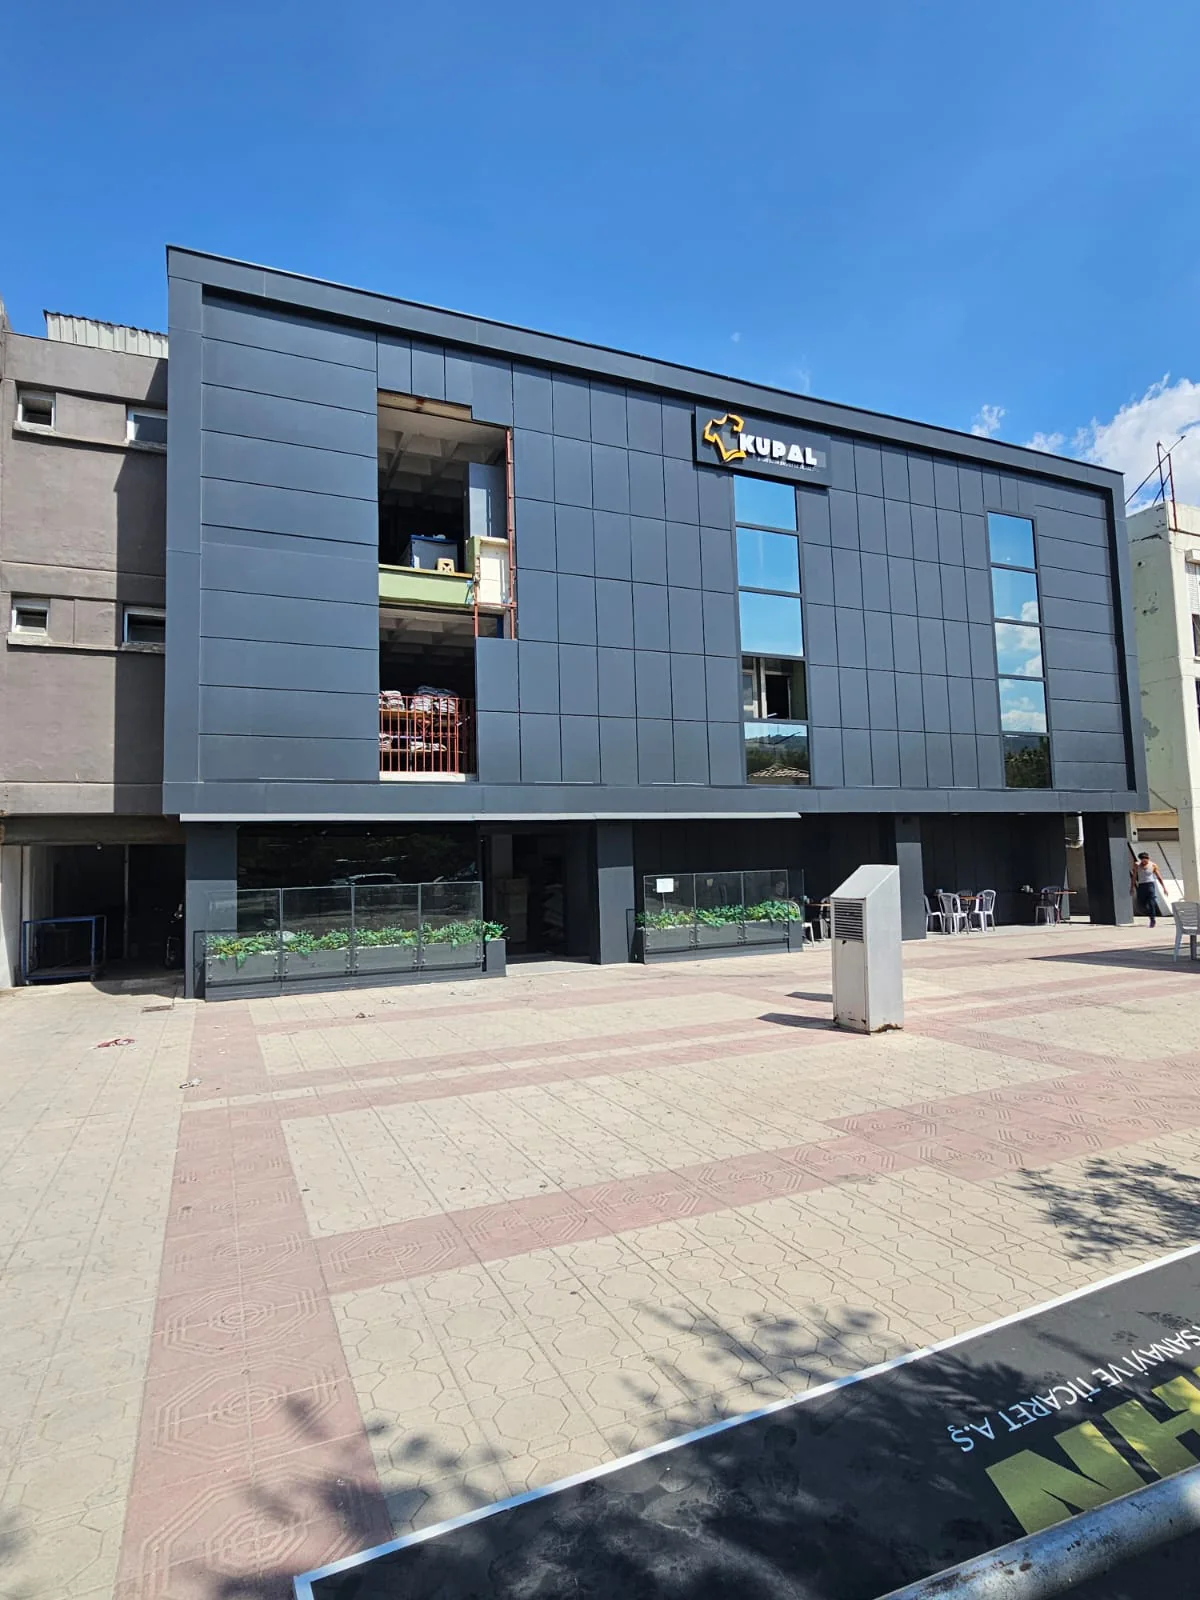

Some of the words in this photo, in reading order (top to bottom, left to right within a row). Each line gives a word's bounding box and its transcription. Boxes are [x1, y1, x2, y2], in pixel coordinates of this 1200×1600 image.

[739, 432, 818, 466] KUPAL
[1121, 1329, 1200, 1376] SANAYİ
[1091, 1362, 1135, 1388] VE
[997, 1376, 1102, 1433] TİCARET
[946, 1416, 996, 1453] A.Ş
